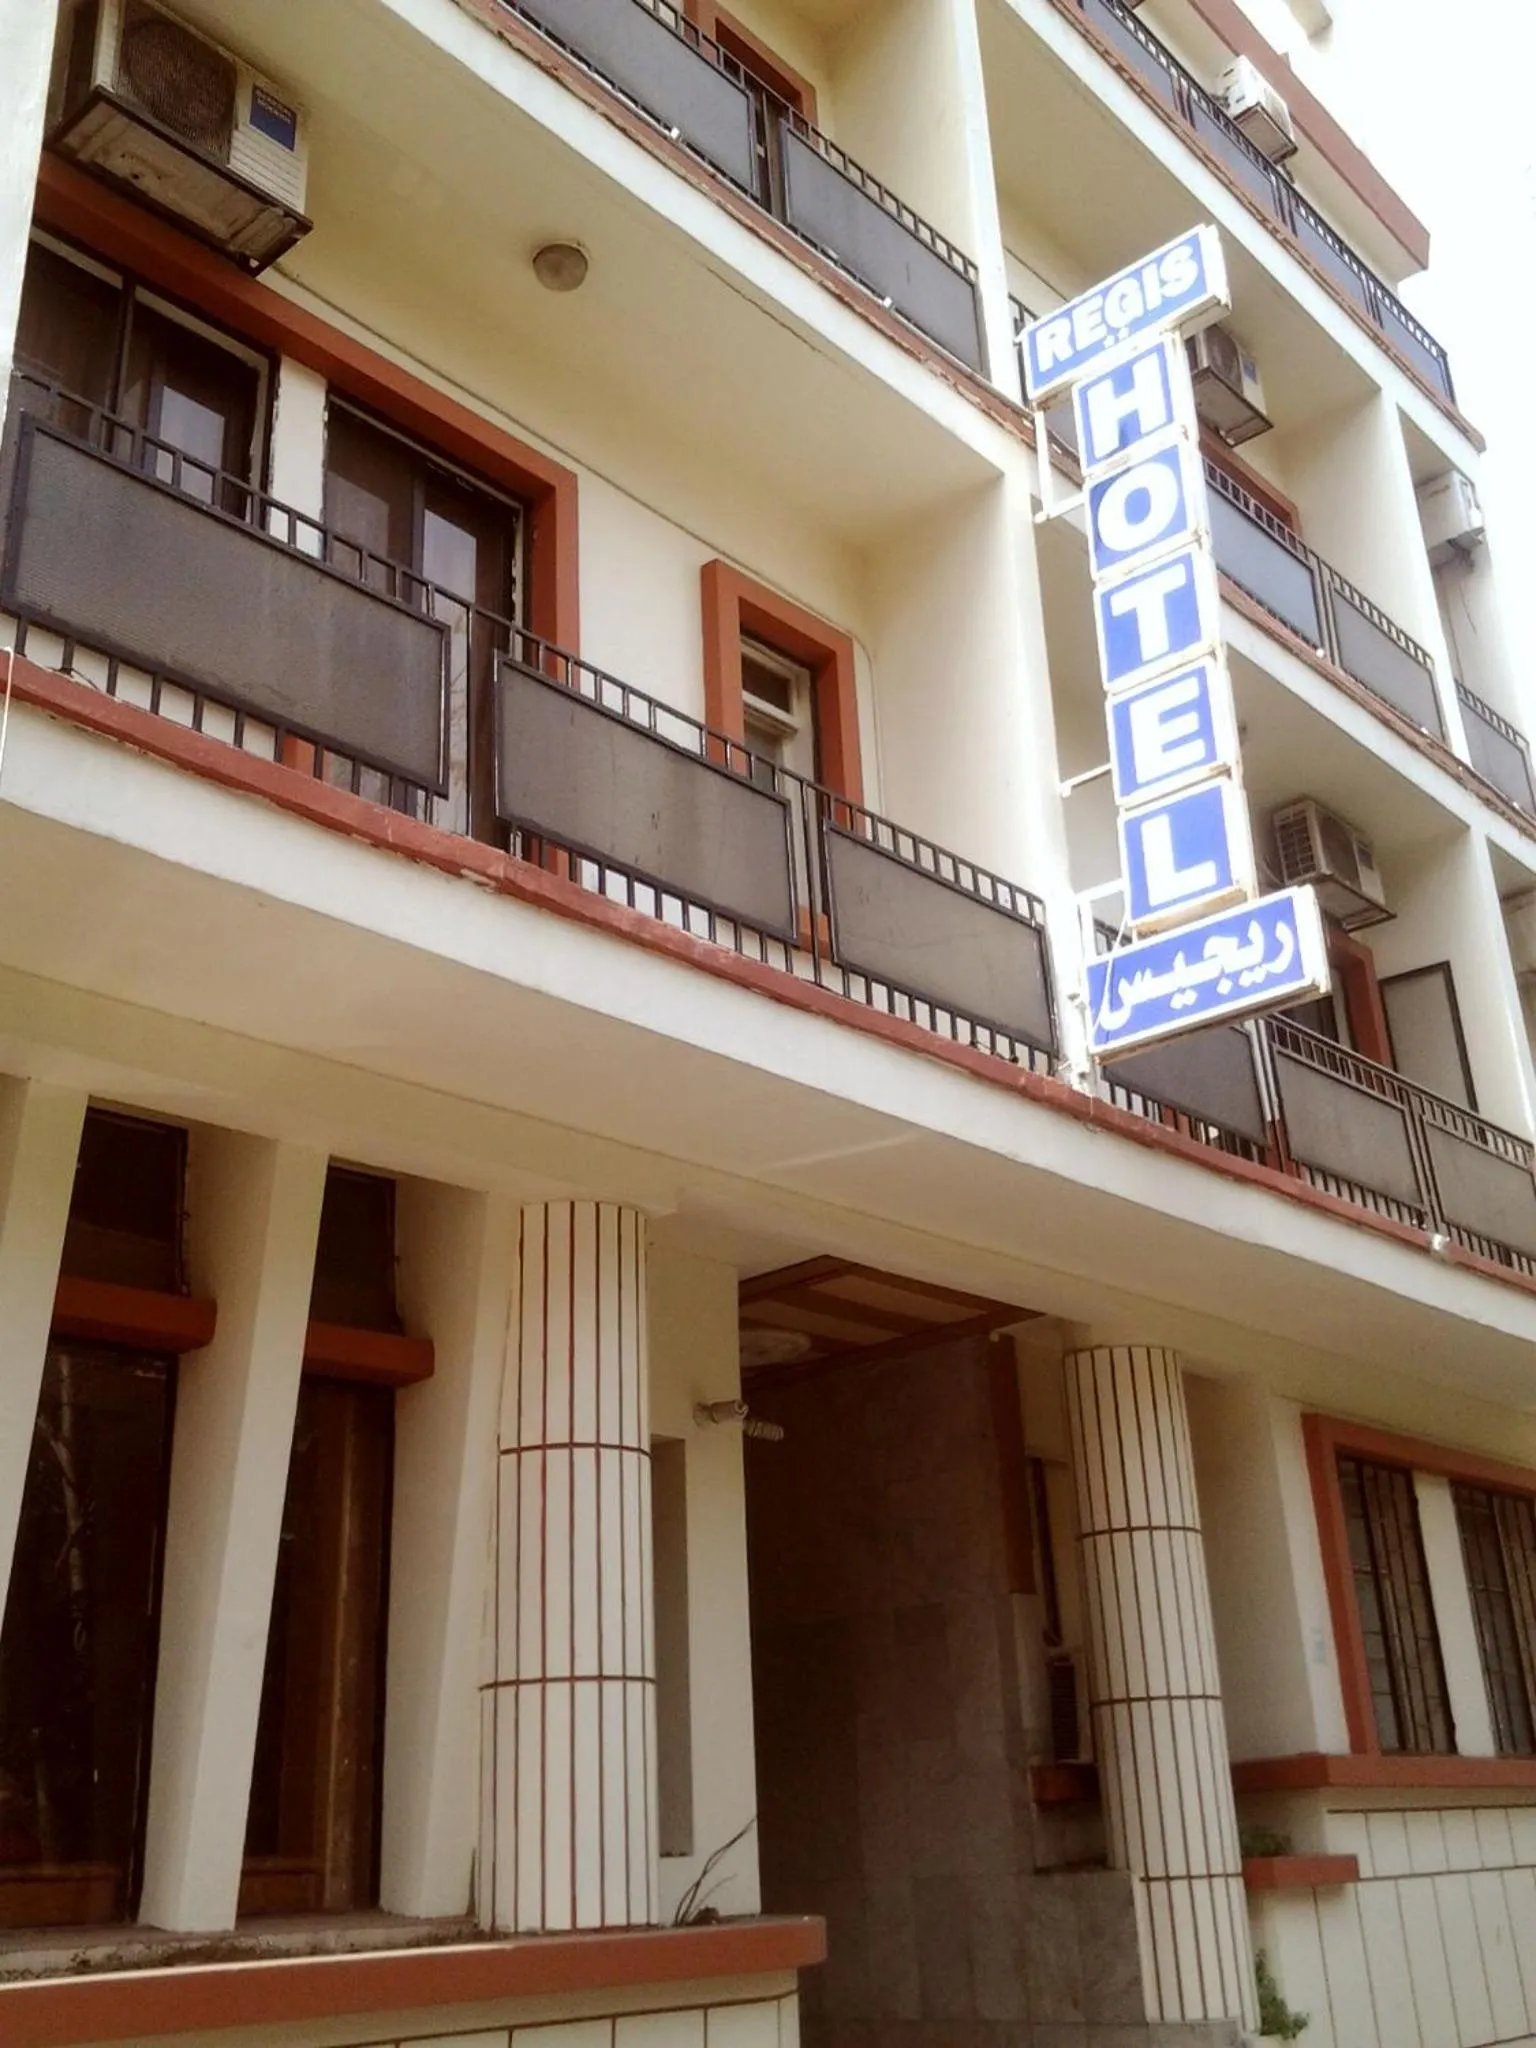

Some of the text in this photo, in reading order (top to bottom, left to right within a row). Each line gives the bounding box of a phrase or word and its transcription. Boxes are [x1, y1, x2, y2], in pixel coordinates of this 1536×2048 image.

[1035, 243, 1199, 373] REGIS
[1086, 351, 1218, 906] HOTEL
[1100, 917, 1294, 1030] ريجيس
